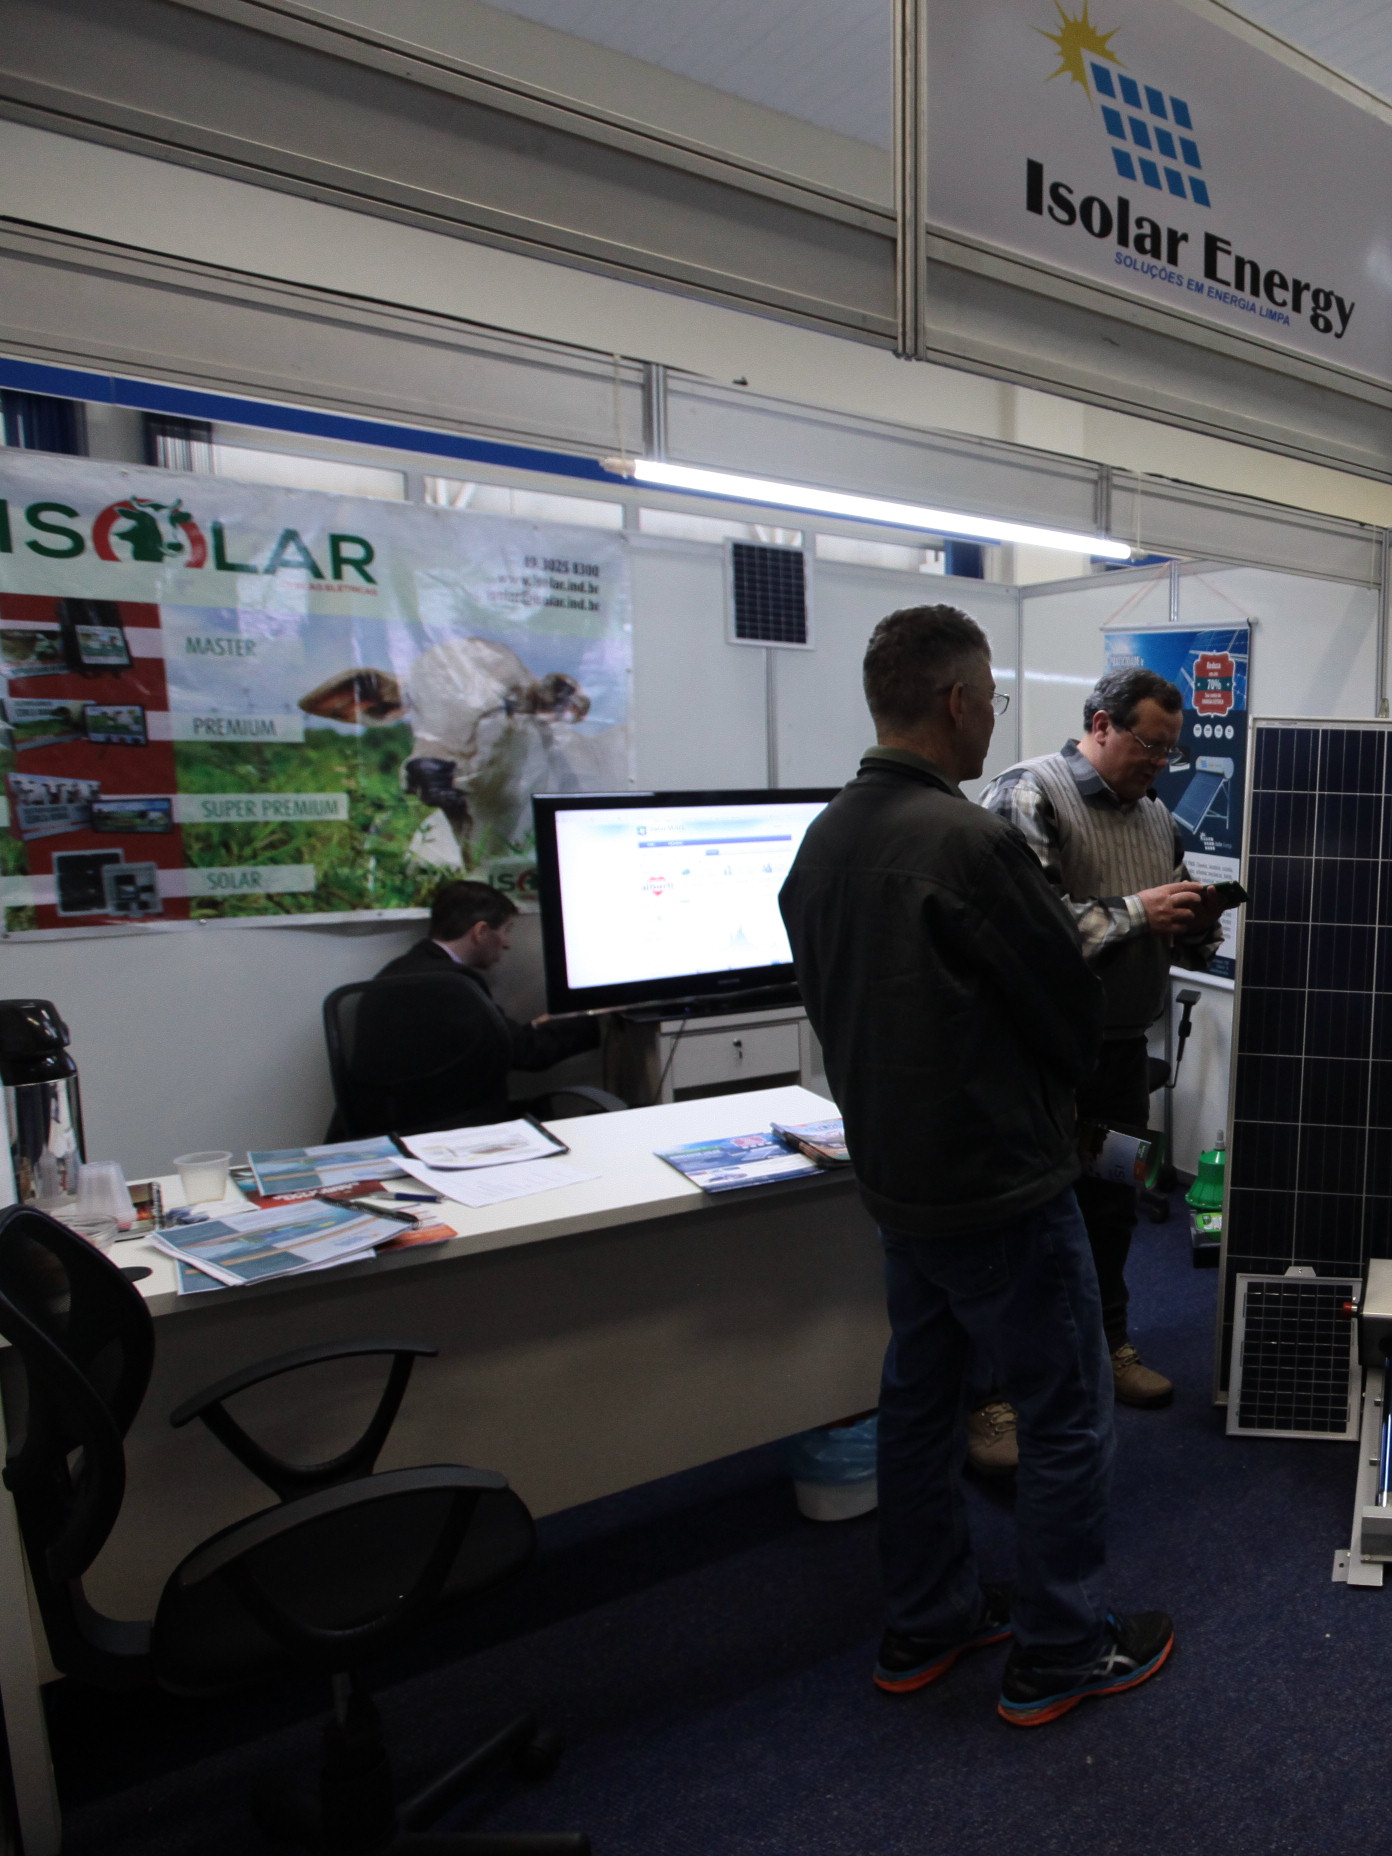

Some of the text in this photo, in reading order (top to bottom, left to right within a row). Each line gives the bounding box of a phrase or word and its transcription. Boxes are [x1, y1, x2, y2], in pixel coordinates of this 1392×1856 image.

[1026, 157, 1355, 339] Isolar Energy
[1114, 251, 1290, 327] SOLUÇÕES EM ENERGIA LIMPA
[0, 497, 377, 584] ISOLAR
[185, 636, 257, 657] MASTER
[193, 717, 277, 737] PREMIUM
[202, 800, 339, 818] SUPER PREMIUM
[207, 871, 263, 890] SOLAR
